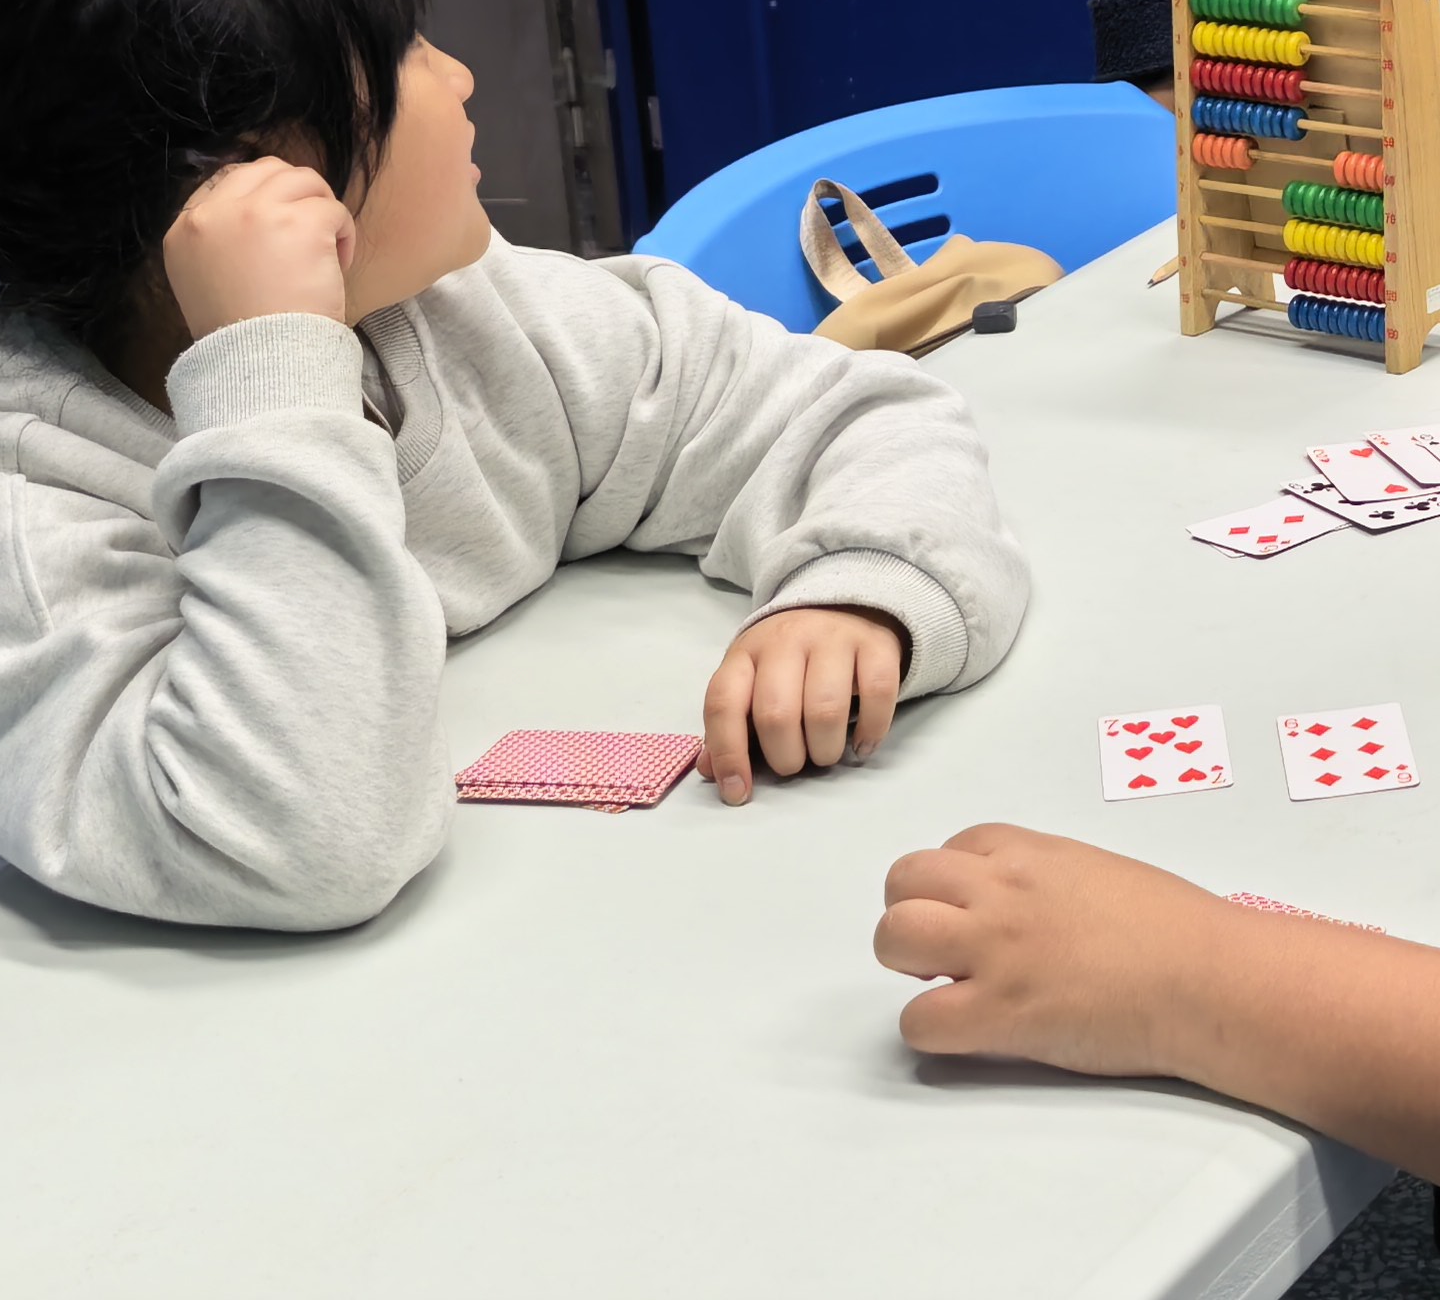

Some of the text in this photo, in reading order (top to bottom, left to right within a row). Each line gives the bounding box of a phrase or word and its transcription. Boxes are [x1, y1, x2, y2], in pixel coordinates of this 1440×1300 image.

[1381, 21, 1393, 32] 20
[1383, 137, 1395, 147] 50
[1385, 214, 1396, 224] 70
[1104, 719, 1120, 730] 7
[1284, 718, 1299, 729] 6
[1210, 772, 1227, 786] 7
[1397, 772, 1412, 784] 6
